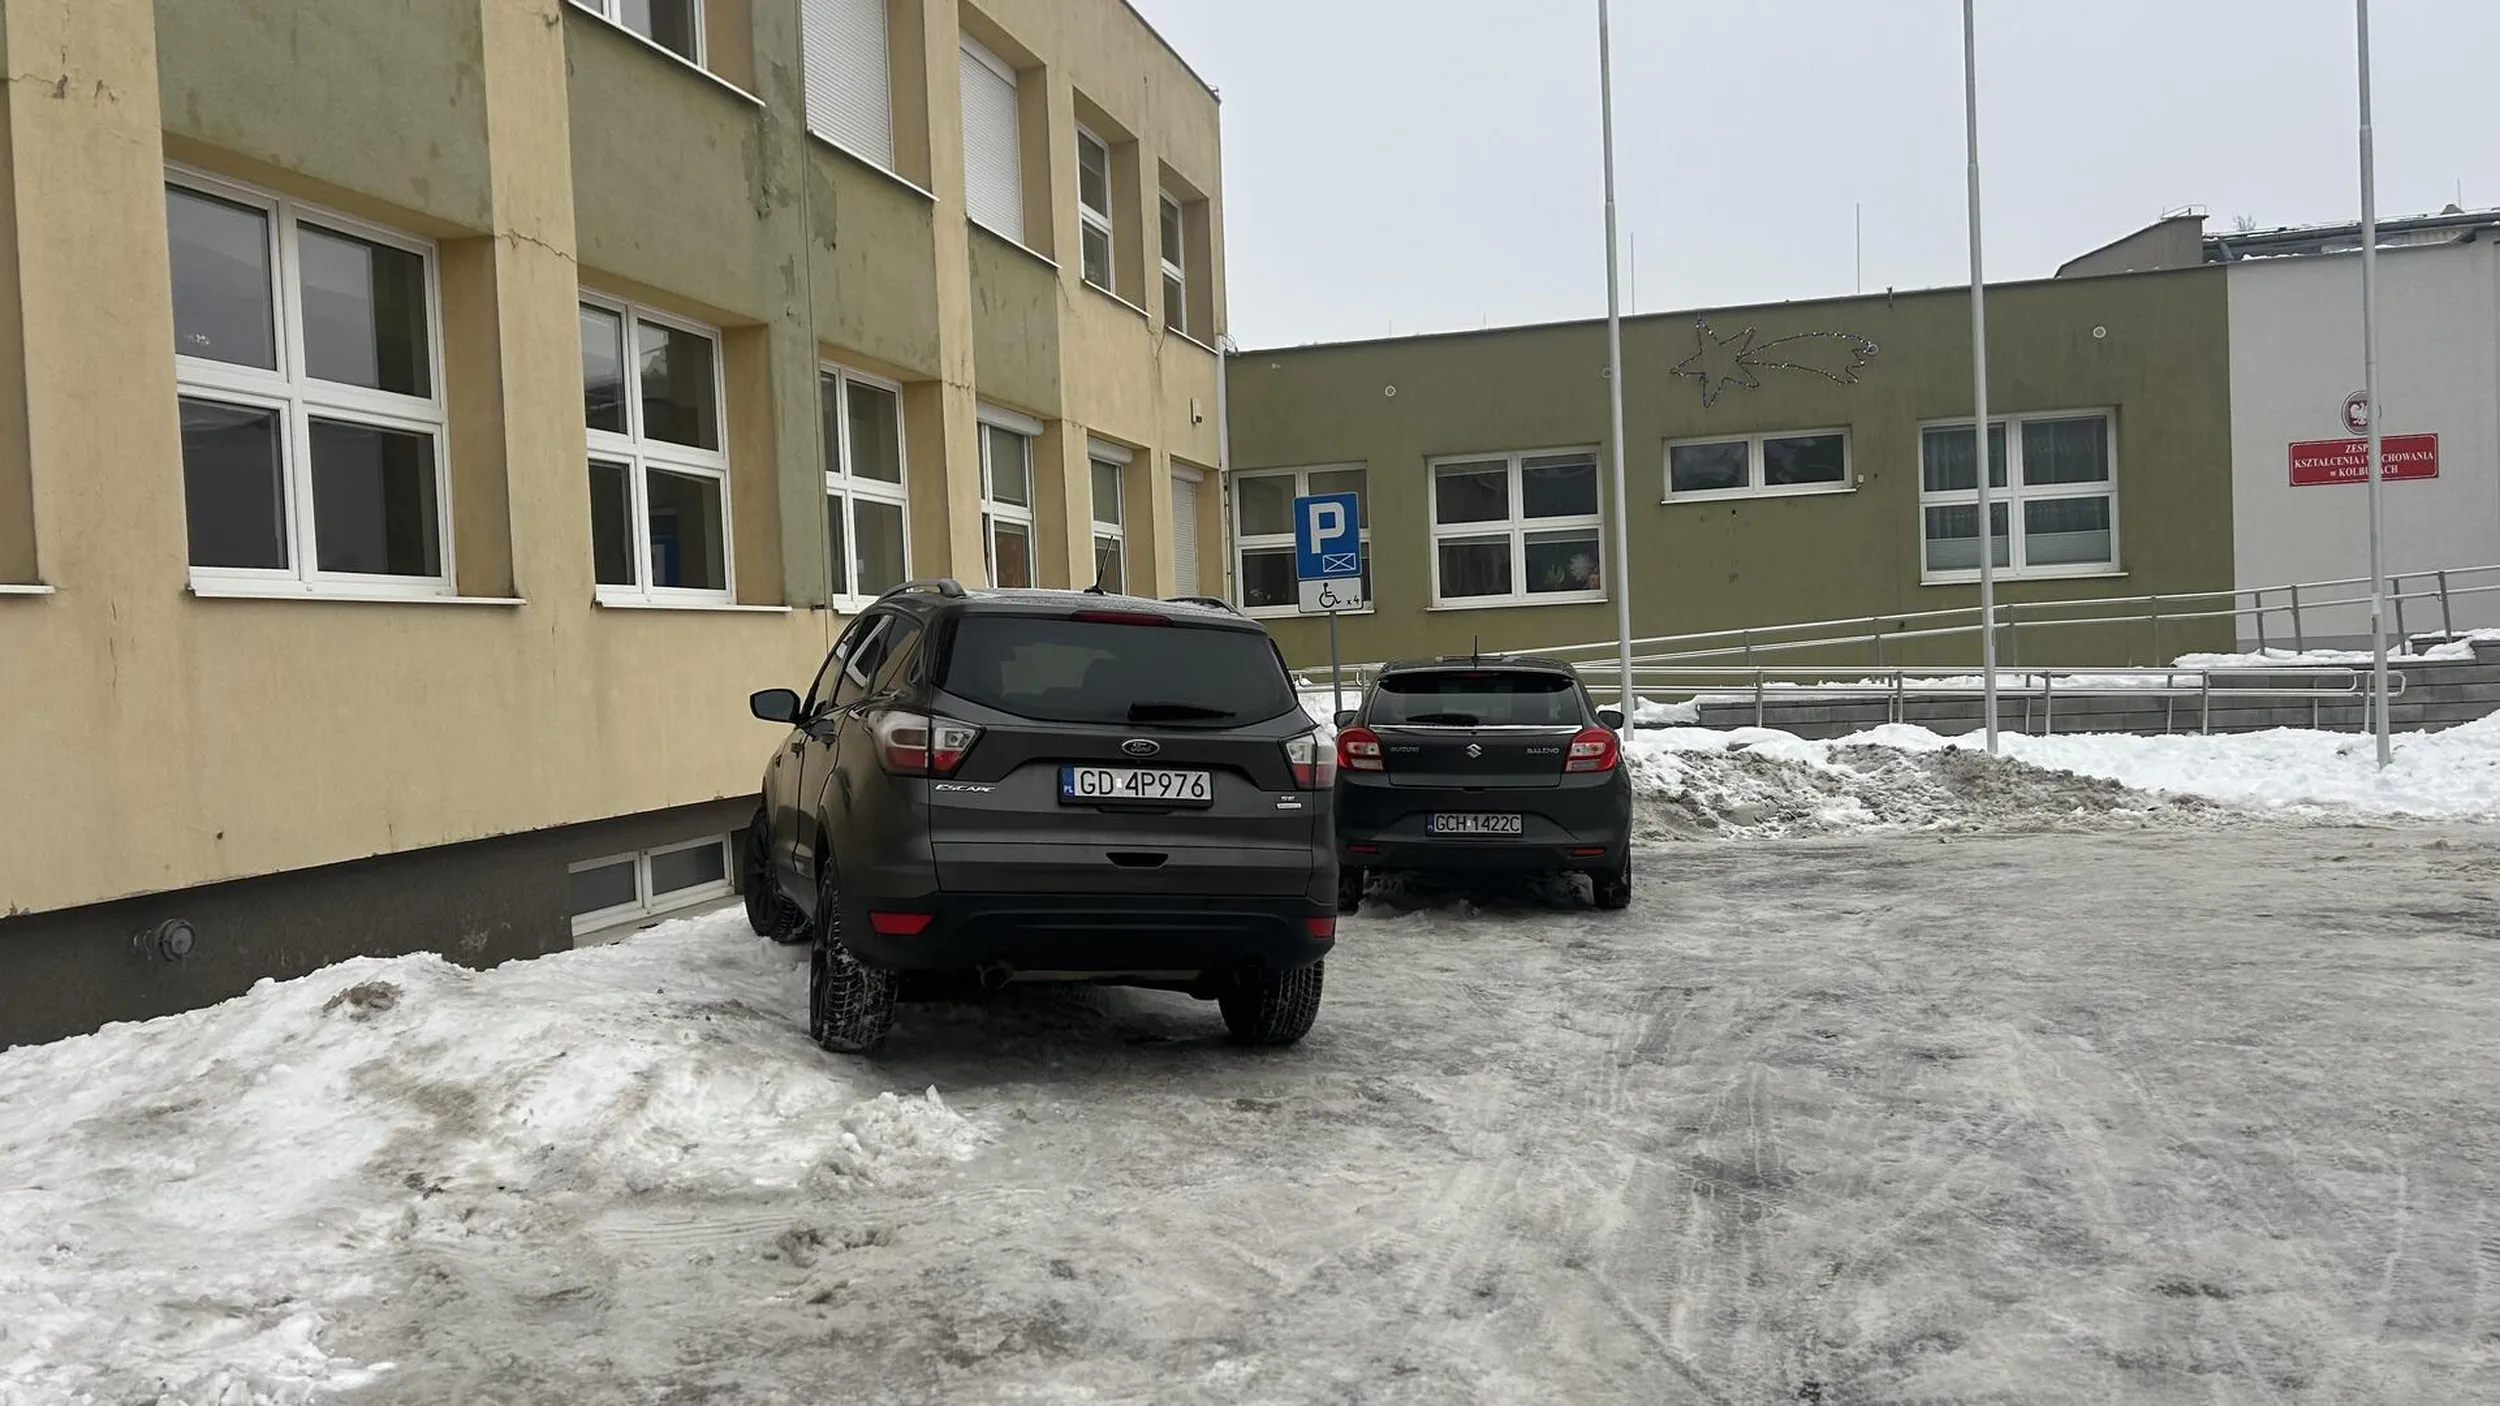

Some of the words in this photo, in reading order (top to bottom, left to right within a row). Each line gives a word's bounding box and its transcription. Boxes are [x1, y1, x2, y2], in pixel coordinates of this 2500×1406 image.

[2345, 443, 2370, 454] ZESP
[2361, 456, 2365, 464] i
[2366, 451, 2434, 463] CHOWANIA
[1309, 502, 1345, 554] P
[1080, 770, 1114, 795] GD
[1125, 771, 1205, 798] 4P976
[1436, 815, 1466, 831] GCH
[1472, 815, 1520, 832] 1422C
